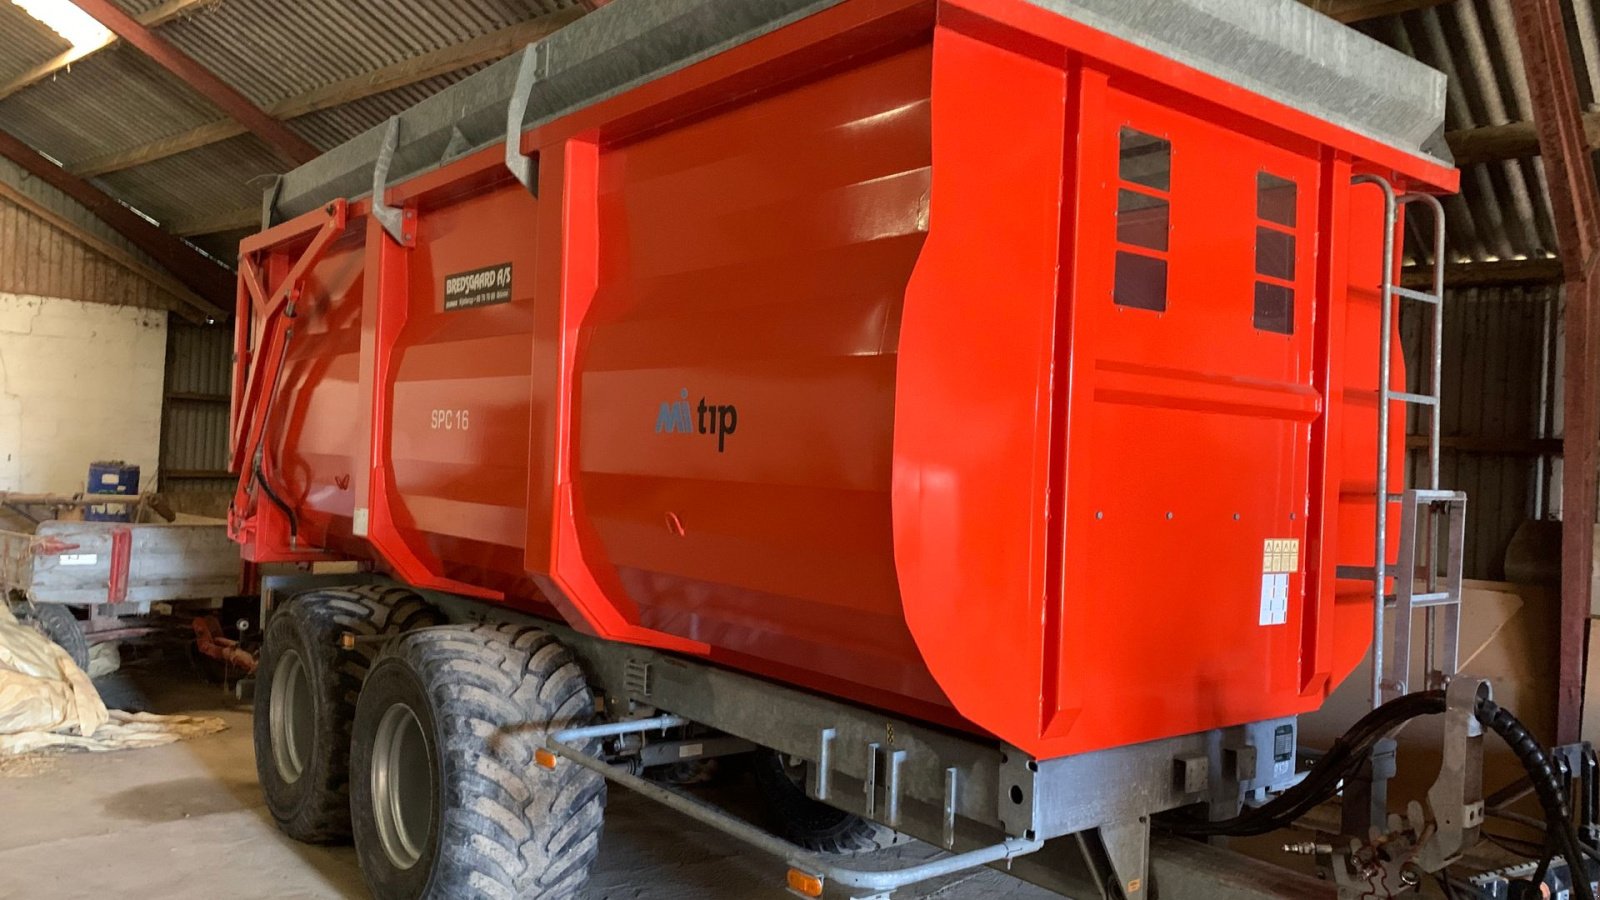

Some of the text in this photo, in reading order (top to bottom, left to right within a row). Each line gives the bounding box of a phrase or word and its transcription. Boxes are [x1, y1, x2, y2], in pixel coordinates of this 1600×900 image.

[497, 266, 511, 287] A/S
[431, 409, 470, 431] SPC 16
